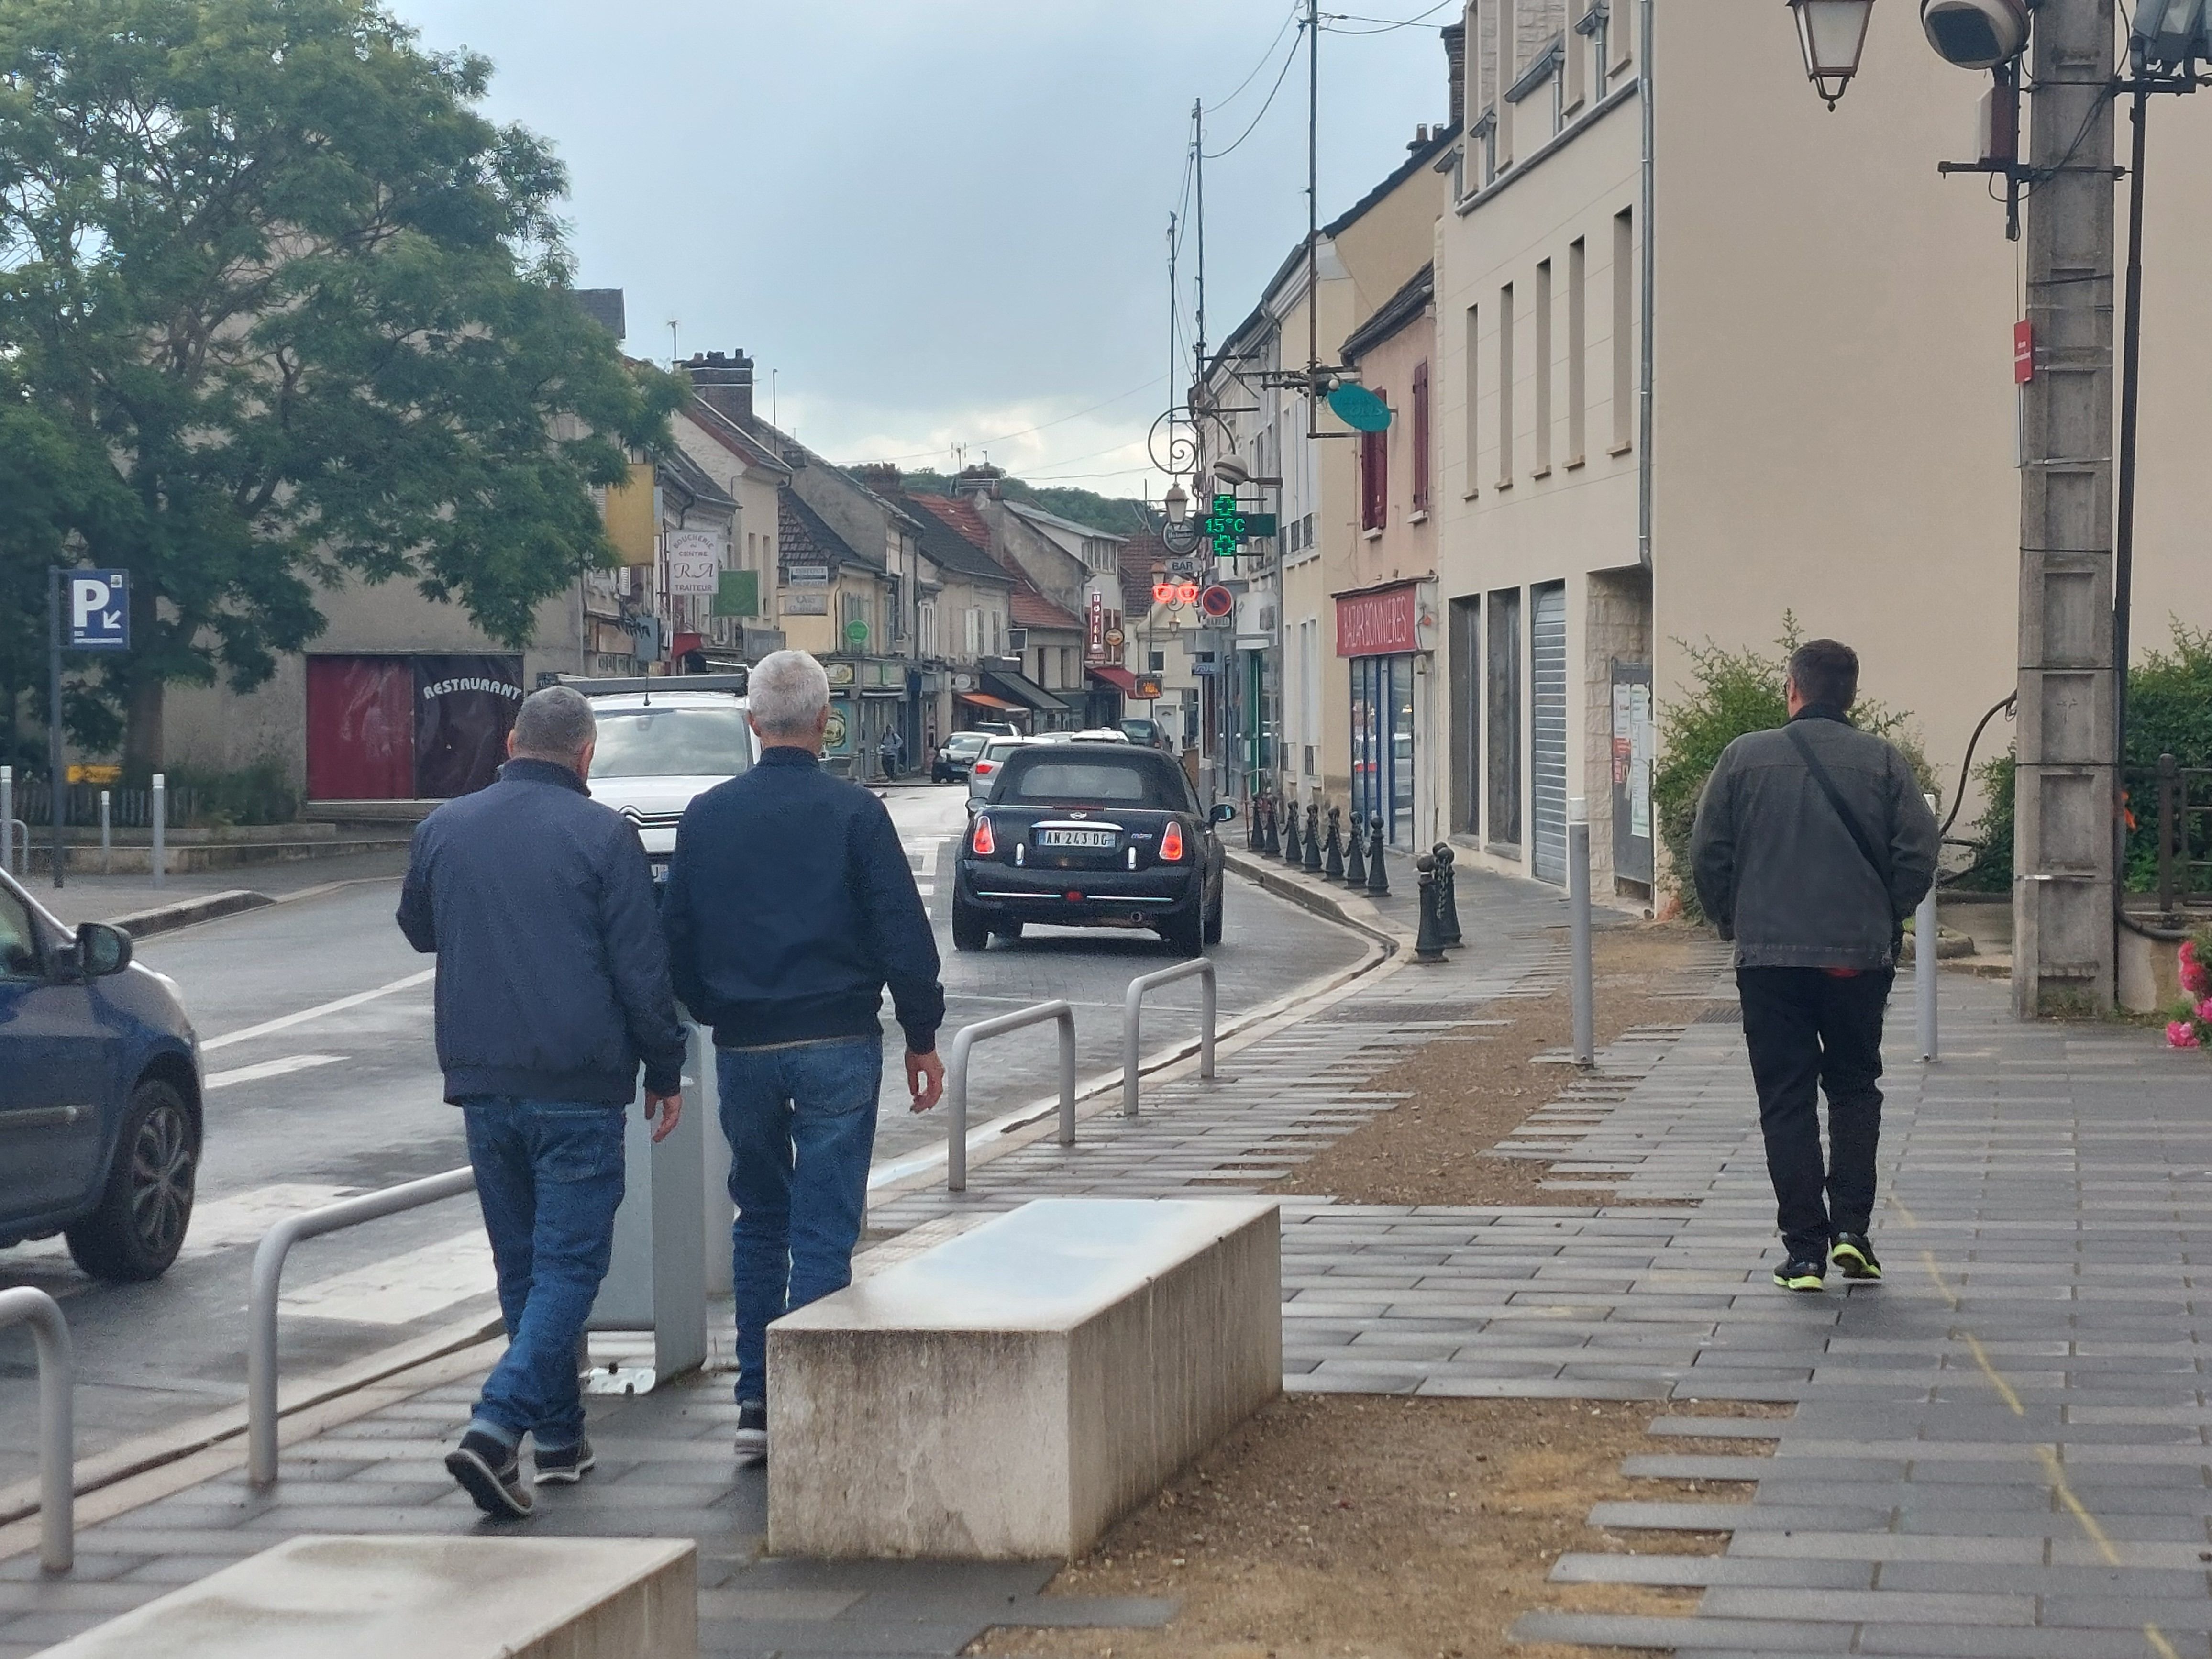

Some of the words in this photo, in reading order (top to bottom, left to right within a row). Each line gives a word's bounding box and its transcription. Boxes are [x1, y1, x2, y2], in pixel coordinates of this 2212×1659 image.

[1205, 518, 1245, 533] 15°C
[673, 534, 714, 550] BOUCHERIE
[1172, 561, 1193, 570] BAR
[73, 579, 110, 627] P
[423, 677, 523, 700] RESTAURANT
[1046, 832, 1060, 844] AN
